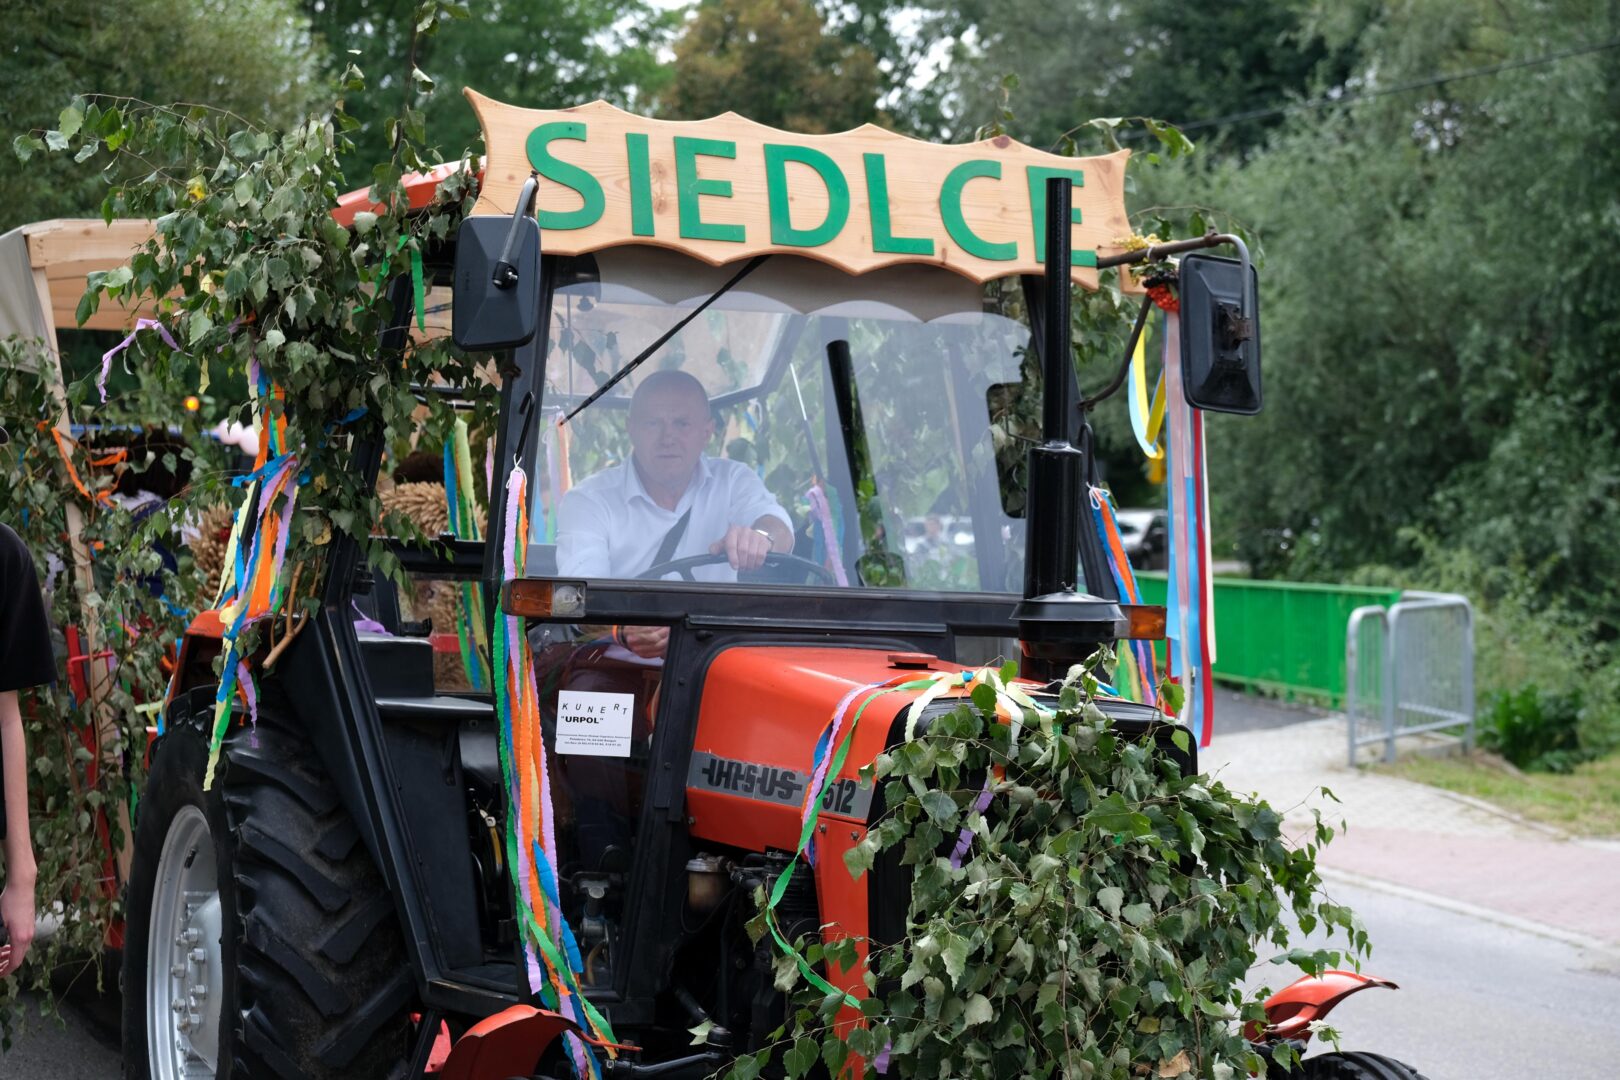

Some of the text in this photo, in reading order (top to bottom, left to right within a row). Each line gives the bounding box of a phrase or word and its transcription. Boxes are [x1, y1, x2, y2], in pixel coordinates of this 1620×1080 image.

[525, 121, 1097, 268] SIEDLCE
[561, 702, 628, 715] KUNERT
[702, 758, 857, 814] URSUS 512
